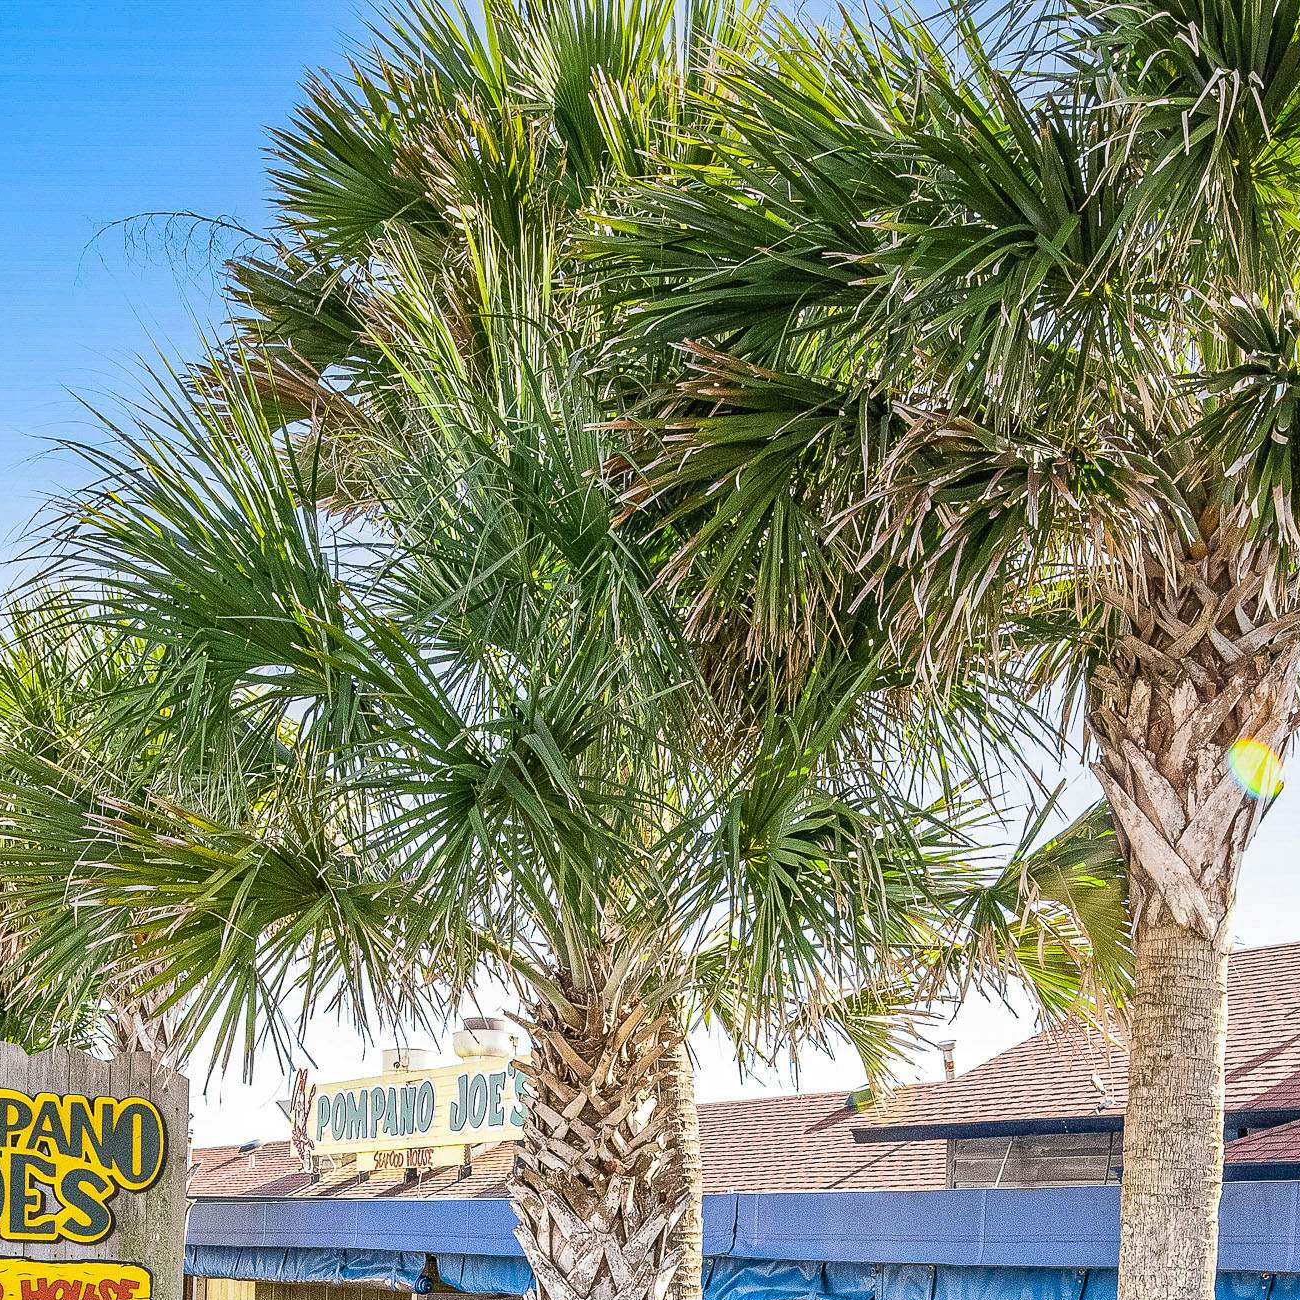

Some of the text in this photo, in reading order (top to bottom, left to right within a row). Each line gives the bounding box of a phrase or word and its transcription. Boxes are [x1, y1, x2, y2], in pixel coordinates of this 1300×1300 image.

[316, 1063, 531, 1142] POMPANO JOE'S
[373, 1149, 435, 1170] SEAFOOD HOUSE
